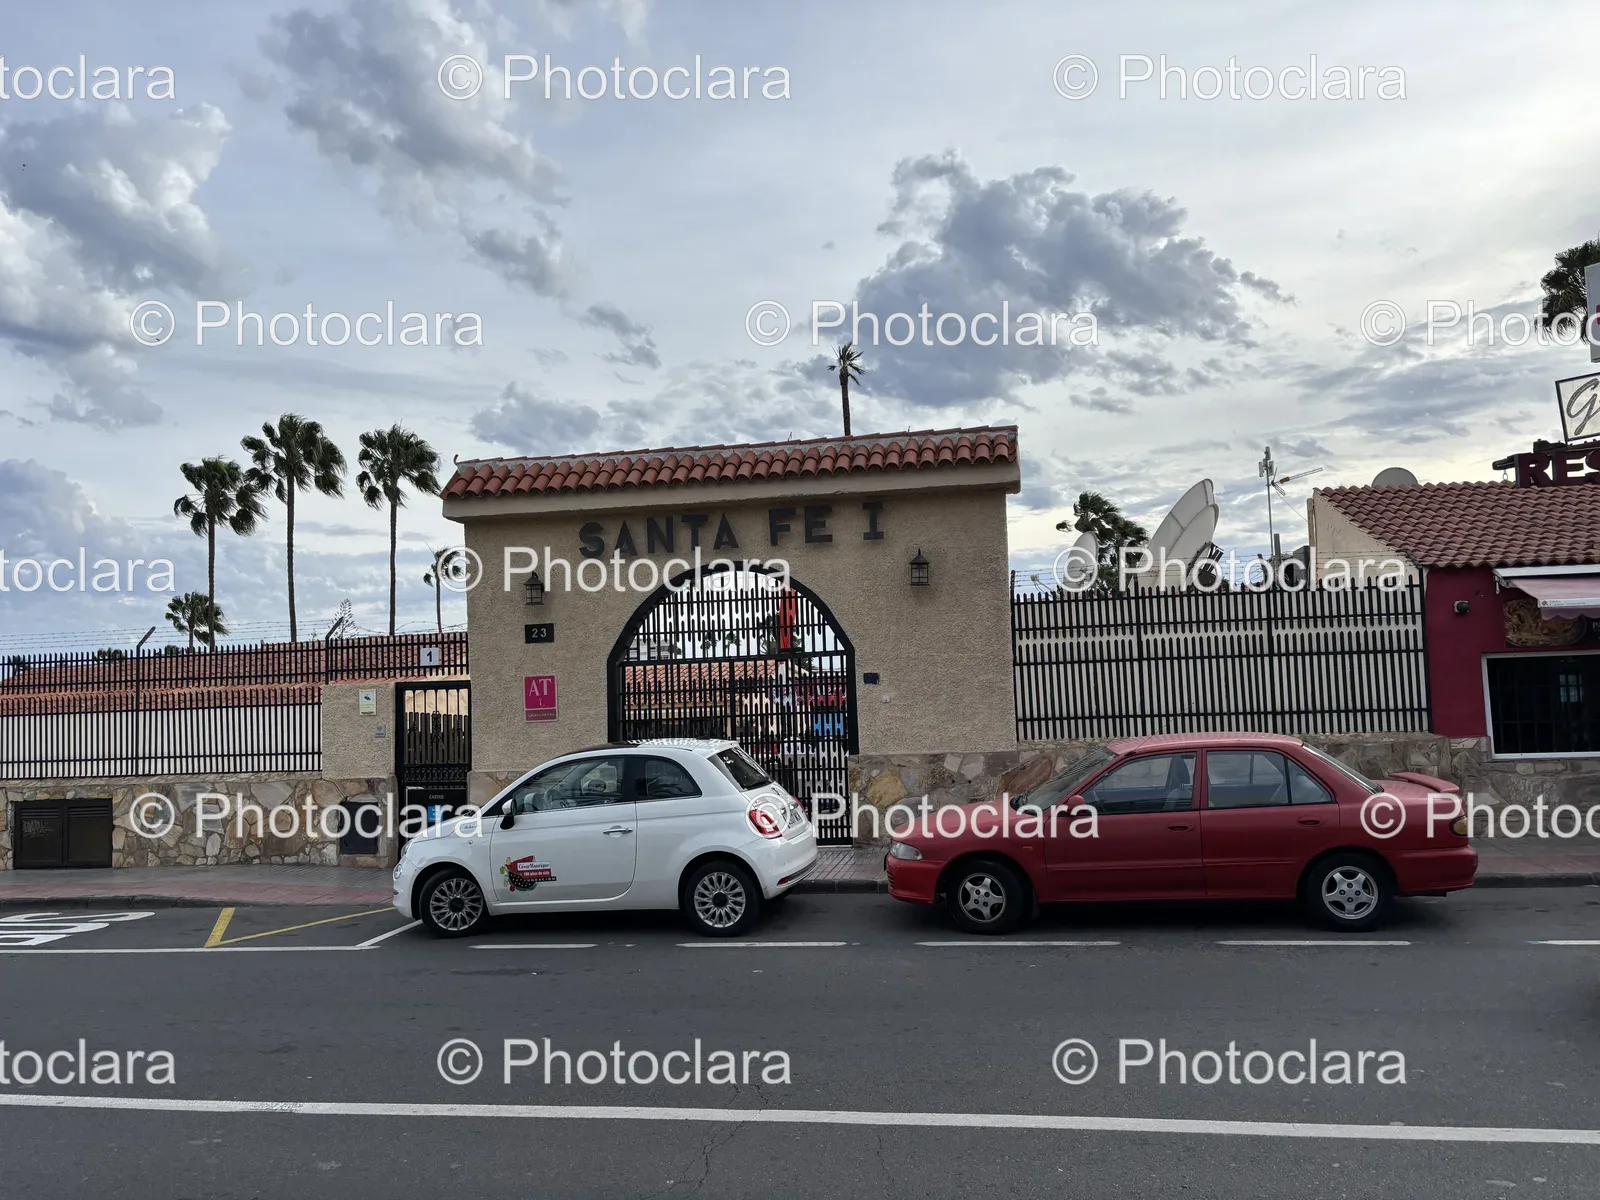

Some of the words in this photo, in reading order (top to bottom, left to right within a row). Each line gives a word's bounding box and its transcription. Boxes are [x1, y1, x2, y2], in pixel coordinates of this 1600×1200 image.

[578, 511, 740, 559] SANTA
[768, 505, 834, 546] FE
[862, 501, 885, 541] I
[531, 627, 547, 638] 23
[426, 650, 433, 663] 1
[528, 678, 552, 697] AT
